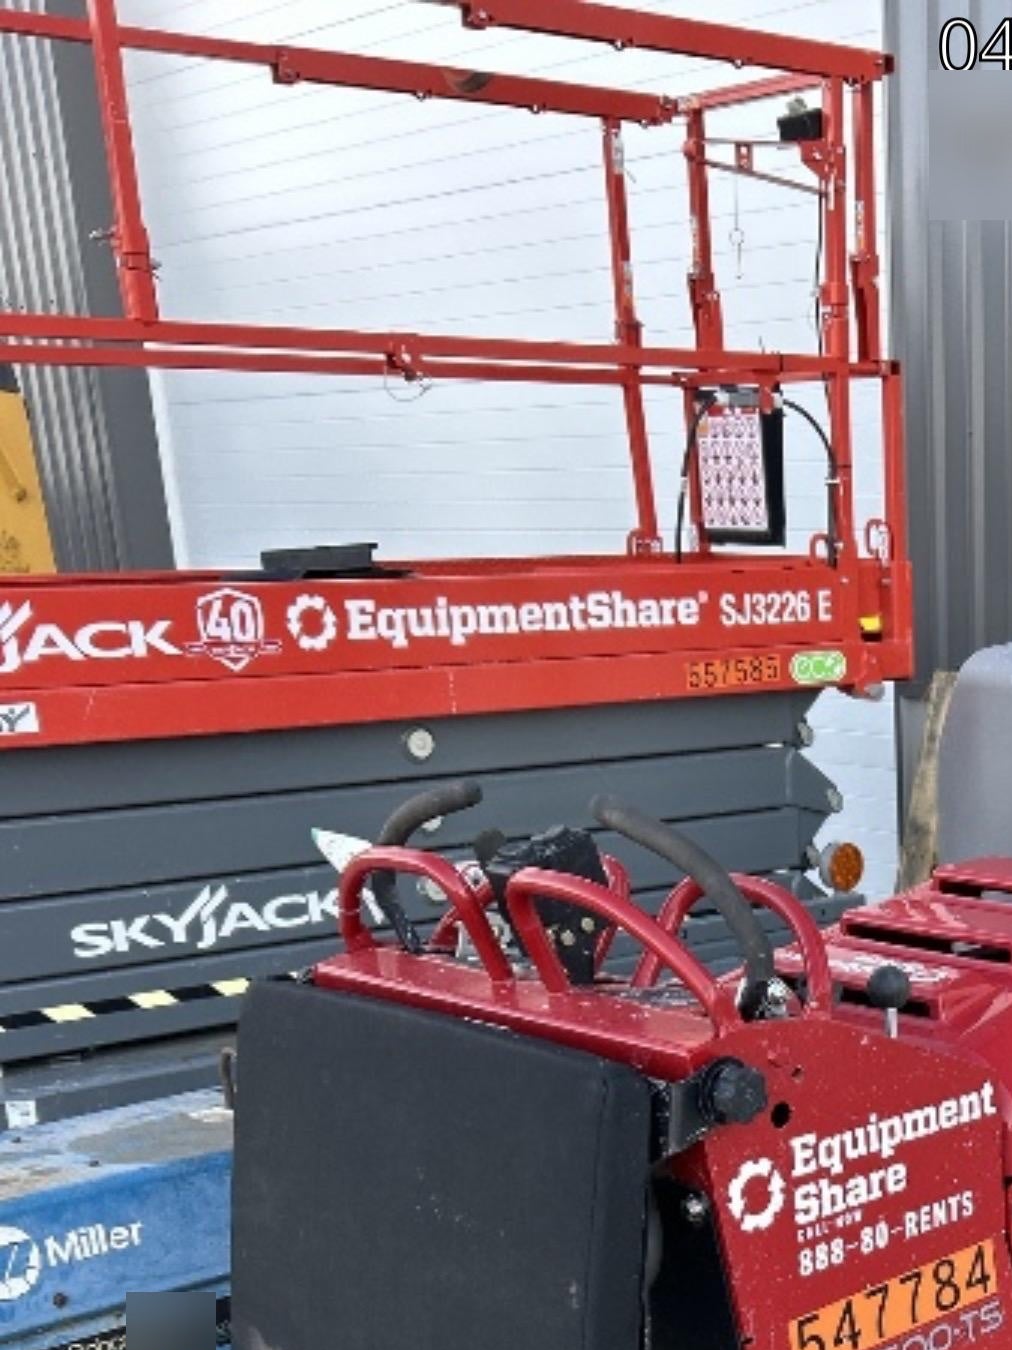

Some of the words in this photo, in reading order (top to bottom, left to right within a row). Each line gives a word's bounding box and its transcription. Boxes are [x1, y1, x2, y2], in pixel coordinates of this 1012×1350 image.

[0, 600, 183, 673] JACK
[206, 597, 257, 642] 40
[344, 591, 702, 648] EquipmentShare
[720, 590, 811, 627] SJ3226
[818, 590, 832, 622] E
[71, 884, 385, 958] SKYJACK
[789, 1079, 997, 1176] Equipment
[793, 1162, 908, 1225] Share
[45, 1220, 144, 1267] Miller
[799, 1191, 974, 1277] 888-80-RENTS
